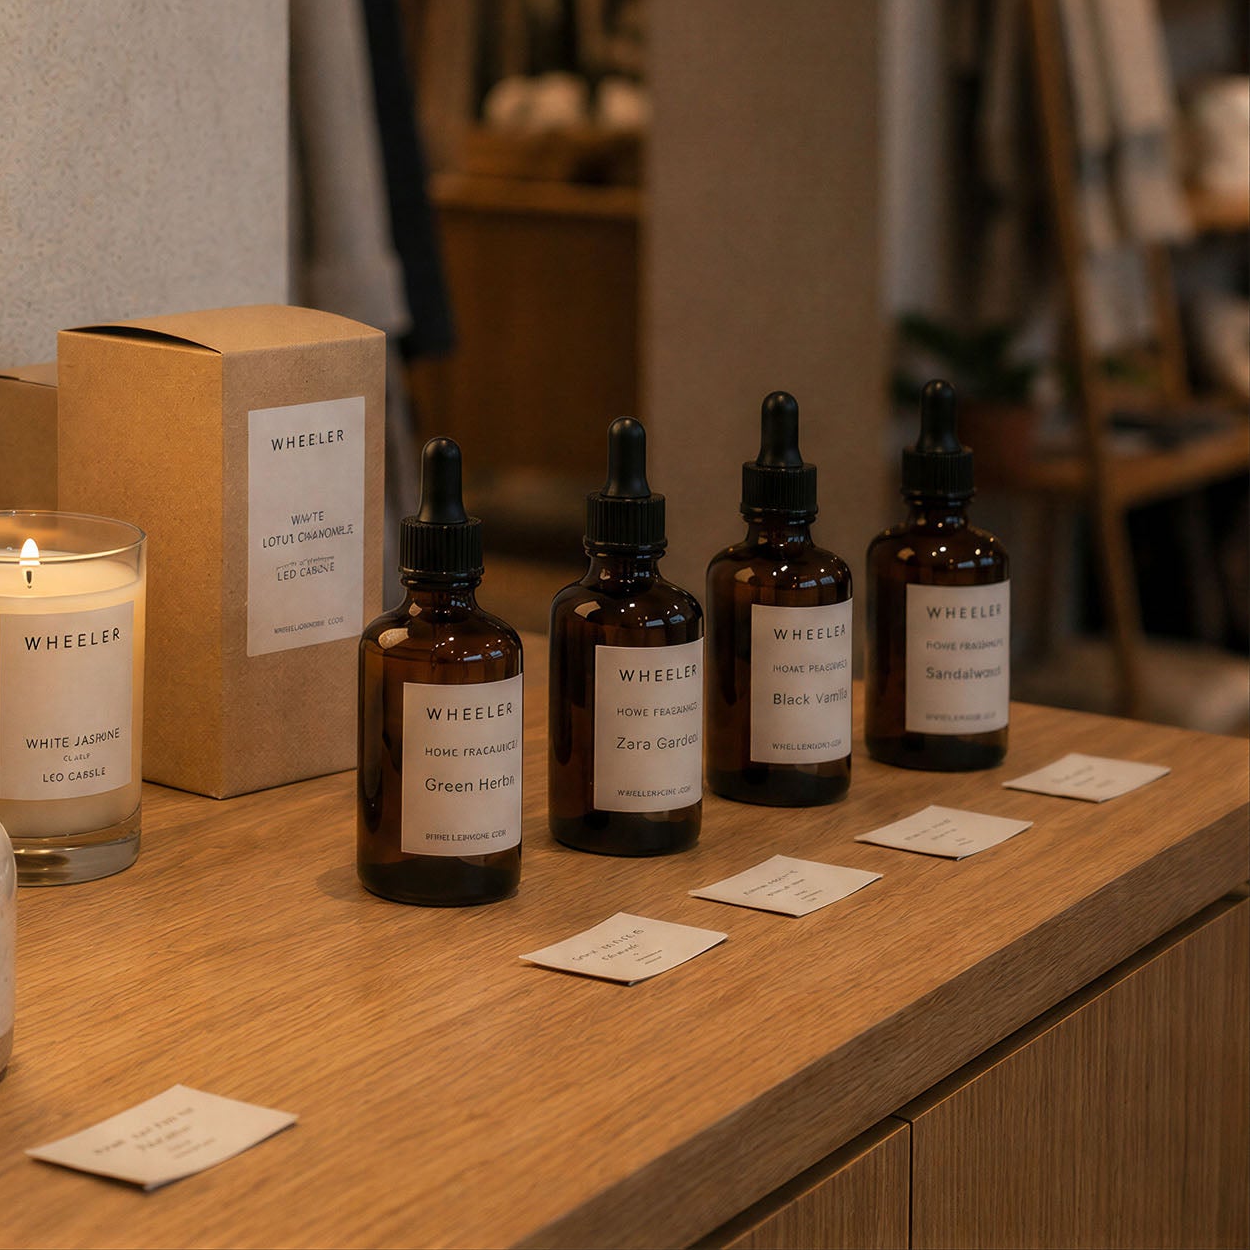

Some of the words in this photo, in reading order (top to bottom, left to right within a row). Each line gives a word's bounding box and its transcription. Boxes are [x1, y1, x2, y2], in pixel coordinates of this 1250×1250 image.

[271, 429, 345, 451] WHEELER
[277, 568, 297, 582] LED
[24, 627, 121, 651] WHEELER
[618, 663, 698, 683] WHEELER
[772, 693, 810, 706] Black
[426, 701, 513, 721] WHEELER
[25, 736, 70, 750] WHITE
[616, 736, 651, 751] Zara
[424, 777, 473, 793] Green
